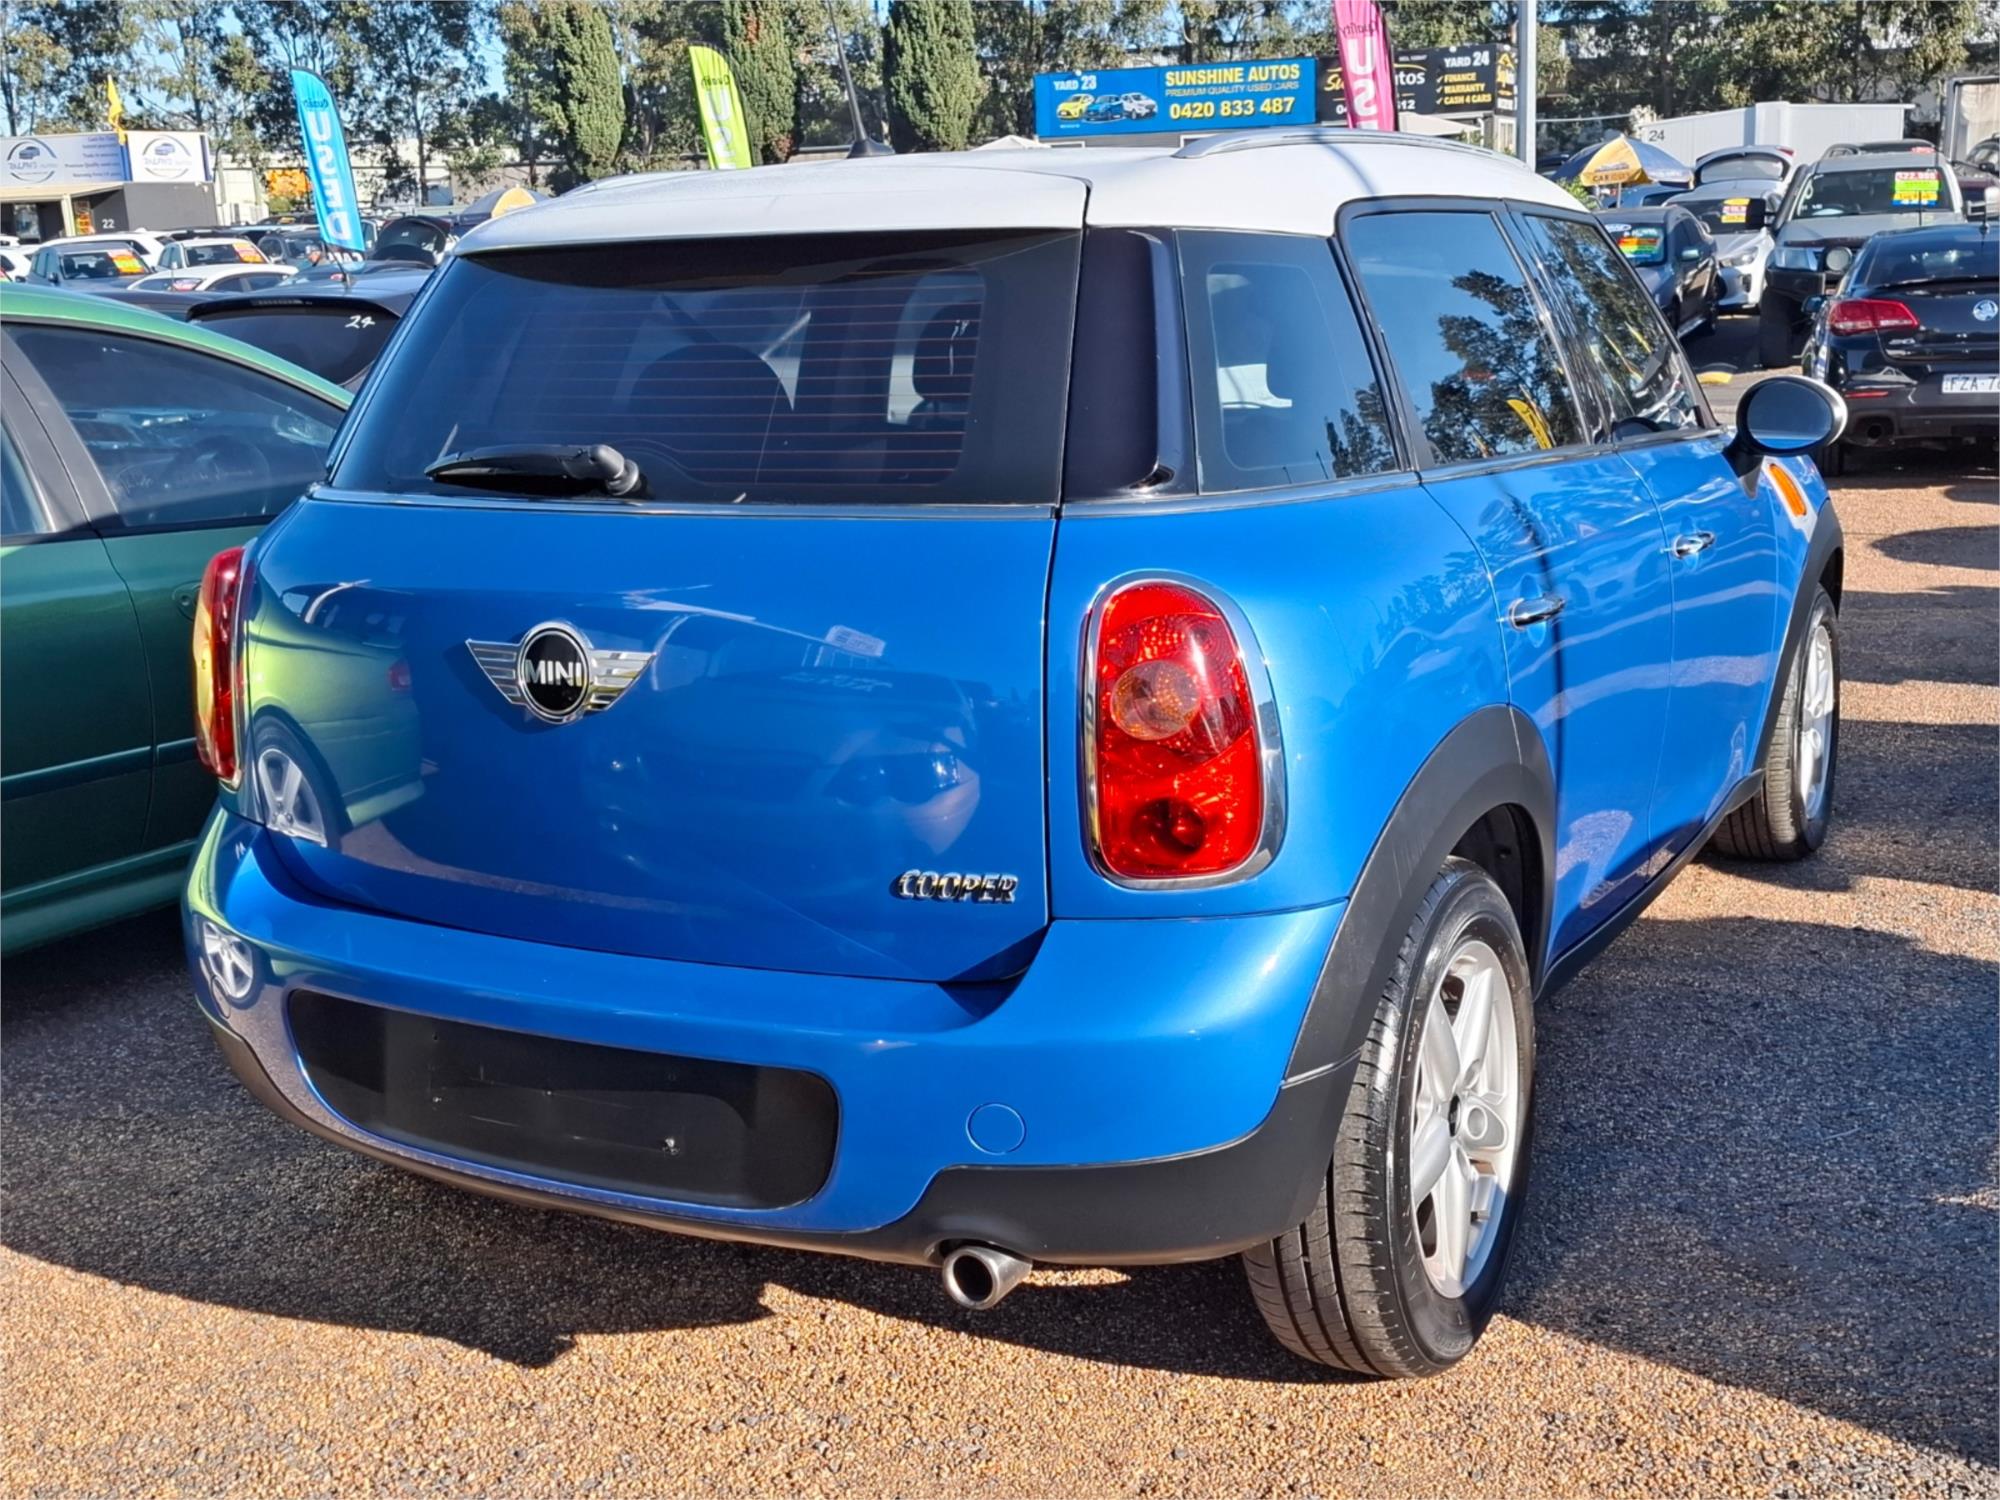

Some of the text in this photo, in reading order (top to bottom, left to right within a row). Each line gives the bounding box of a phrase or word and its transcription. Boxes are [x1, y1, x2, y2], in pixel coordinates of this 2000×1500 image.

[1444, 57, 1471, 68] YARD
[1472, 50, 1490, 67] 24
[1053, 74, 1097, 91] YARD 23
[1165, 64, 1300, 87] SUNSHINE AUTOS
[1444, 72, 1477, 83] FINANCE
[1165, 81, 1300, 97] PREMIUM QUALITY USED CARS
[1444, 83, 1485, 94] WARRANTY
[1444, 93, 1492, 106] CASH 4 CARS
[1169, 97, 1296, 119] 0420 833 487
[1649, 130, 1665, 142] 24
[102, 218, 115, 229] 22
[345, 315, 376, 329] 24
[524, 659, 583, 687] MINI
[898, 868, 1019, 903] COOPER
